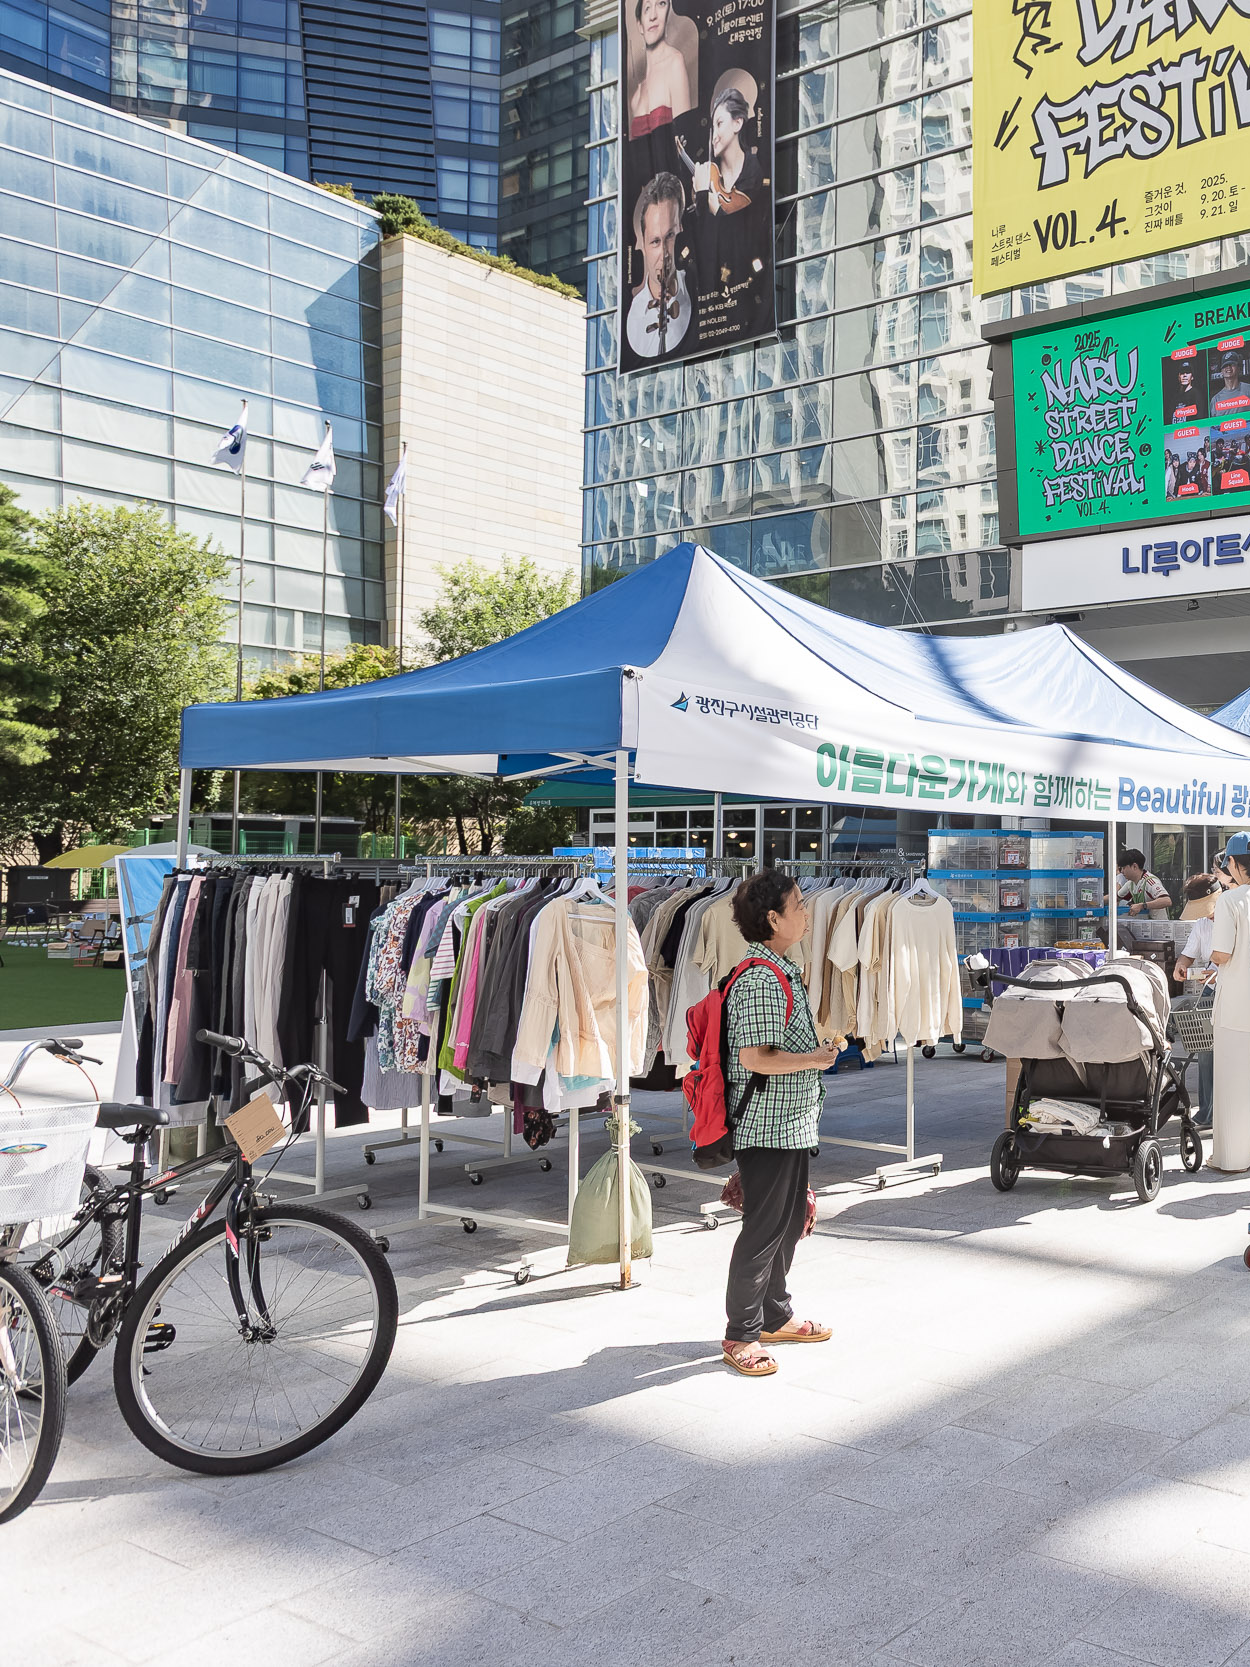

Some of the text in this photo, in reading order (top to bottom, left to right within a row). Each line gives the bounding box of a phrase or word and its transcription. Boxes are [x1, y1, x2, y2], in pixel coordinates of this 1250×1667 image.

[717, 13, 764, 35] 나루아트센터
[730, 27, 763, 43] 대공연장
[1200, 173, 1228, 190] 2025.
[1143, 185, 1172, 204] 즐거운
[1211, 189, 1227, 202] 20.
[1229, 185, 1239, 197] 토
[1144, 201, 1172, 218] 그것이
[1211, 204, 1227, 217] 21.
[1228, 200, 1239, 213] 일
[991, 224, 1006, 239] 나루
[1144, 212, 1184, 233] 진짜 배틀
[991, 231, 1032, 253] 스트릿 댄스
[990, 247, 1021, 267] 페스티벌
[1074, 329, 1100, 351] 2025
[1221, 339, 1241, 349] JUDGE
[1174, 348, 1193, 359] JUDGE
[1040, 346, 1138, 407] NARU
[1044, 397, 1138, 440] STREET
[1223, 420, 1243, 429] GUEST
[1177, 428, 1196, 437] GUEST
[1049, 431, 1135, 472] DANCE
[695, 695, 819, 730] 광진구시설관리공단
[816, 742, 1027, 805] 아름다운가게와
[1033, 772, 1112, 812] 함께하는
[1117, 776, 1227, 817] Beautiful
[897, 847, 905, 857] &
